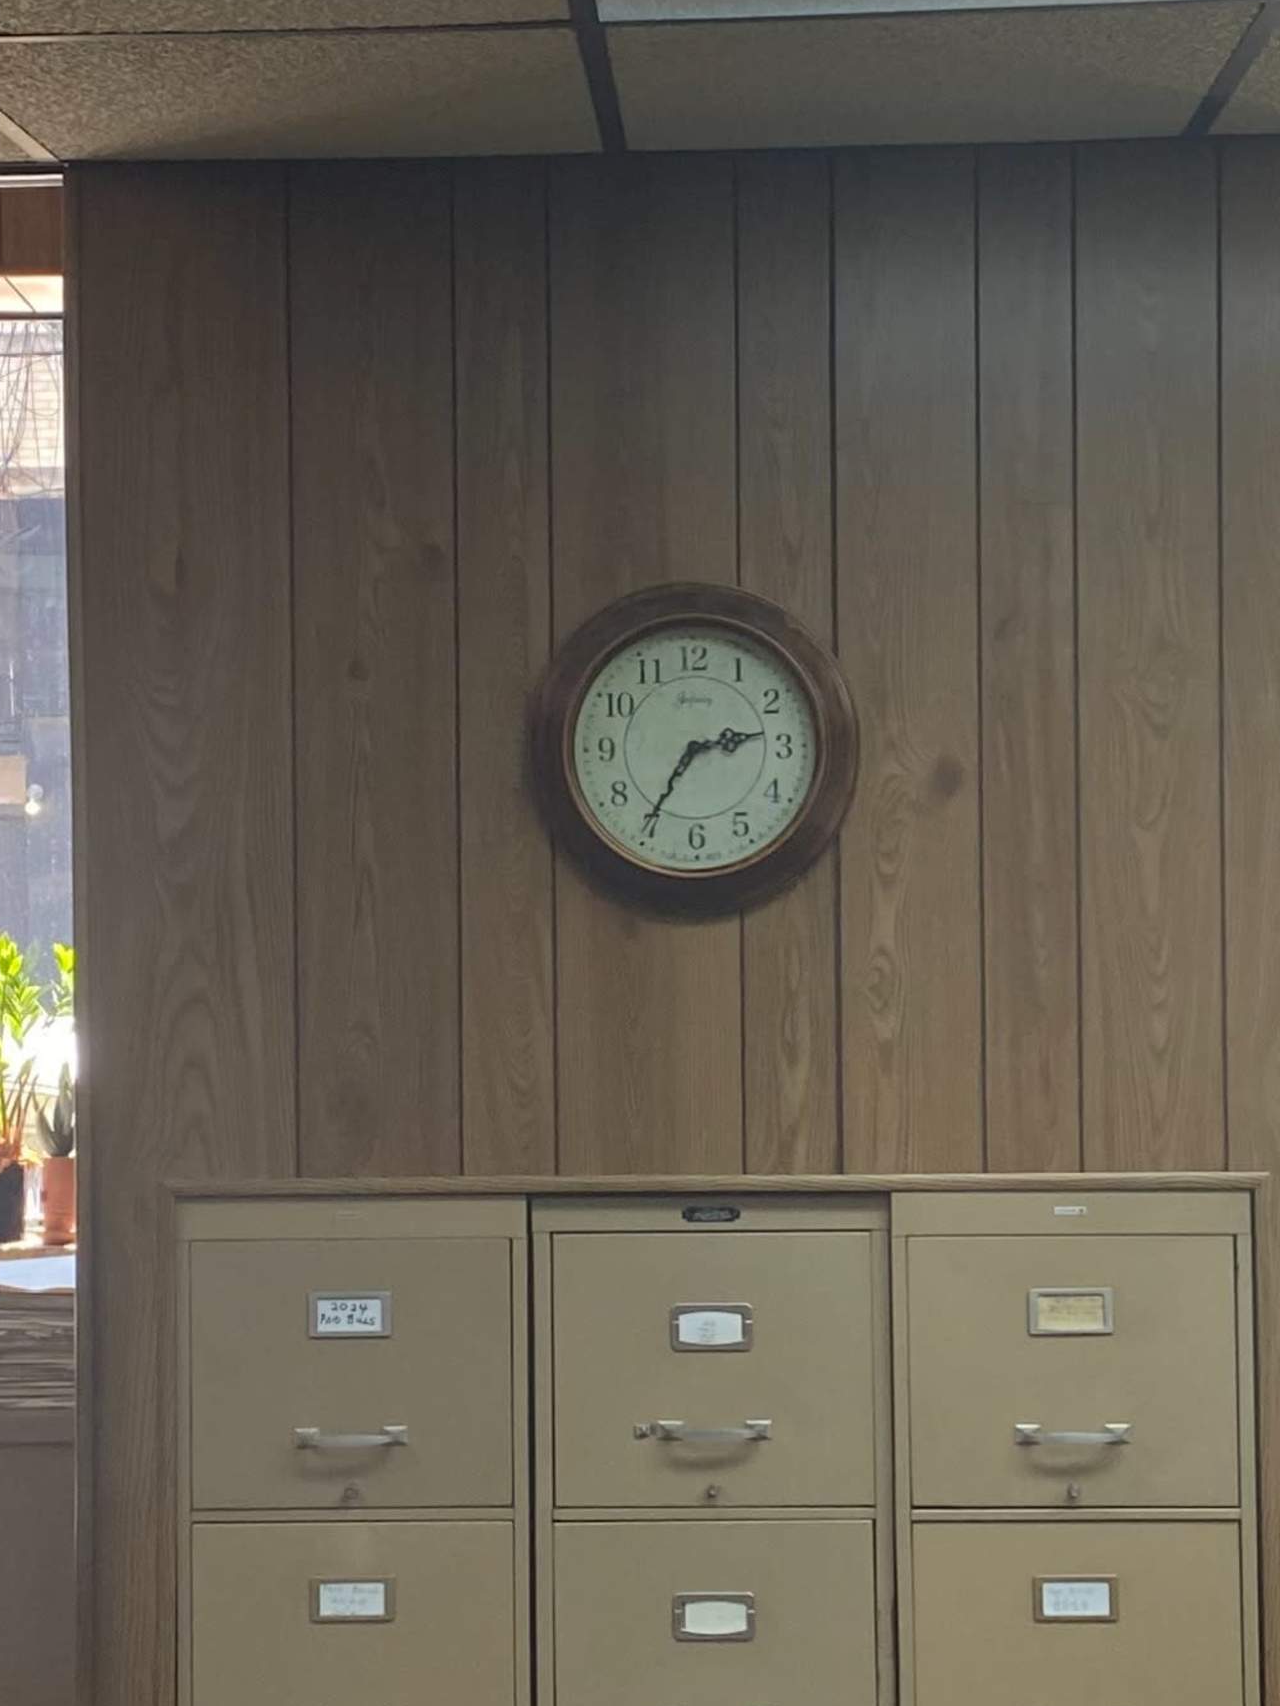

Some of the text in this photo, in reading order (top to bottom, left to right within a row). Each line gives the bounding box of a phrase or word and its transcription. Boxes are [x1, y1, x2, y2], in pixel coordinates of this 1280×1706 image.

[637, 659, 661, 684] 11
[680, 646, 708, 672] 12
[733, 658, 743, 682] 1
[606, 692, 635, 717] 10
[763, 689, 780, 714] 2
[598, 738, 615, 762] 9
[776, 735, 793, 759] 3
[611, 781, 628, 806] 8
[763, 779, 780, 803] 4
[688, 824, 705, 849] 6
[732, 812, 750, 837] 5
[330, 1302, 368, 1315] 2024
